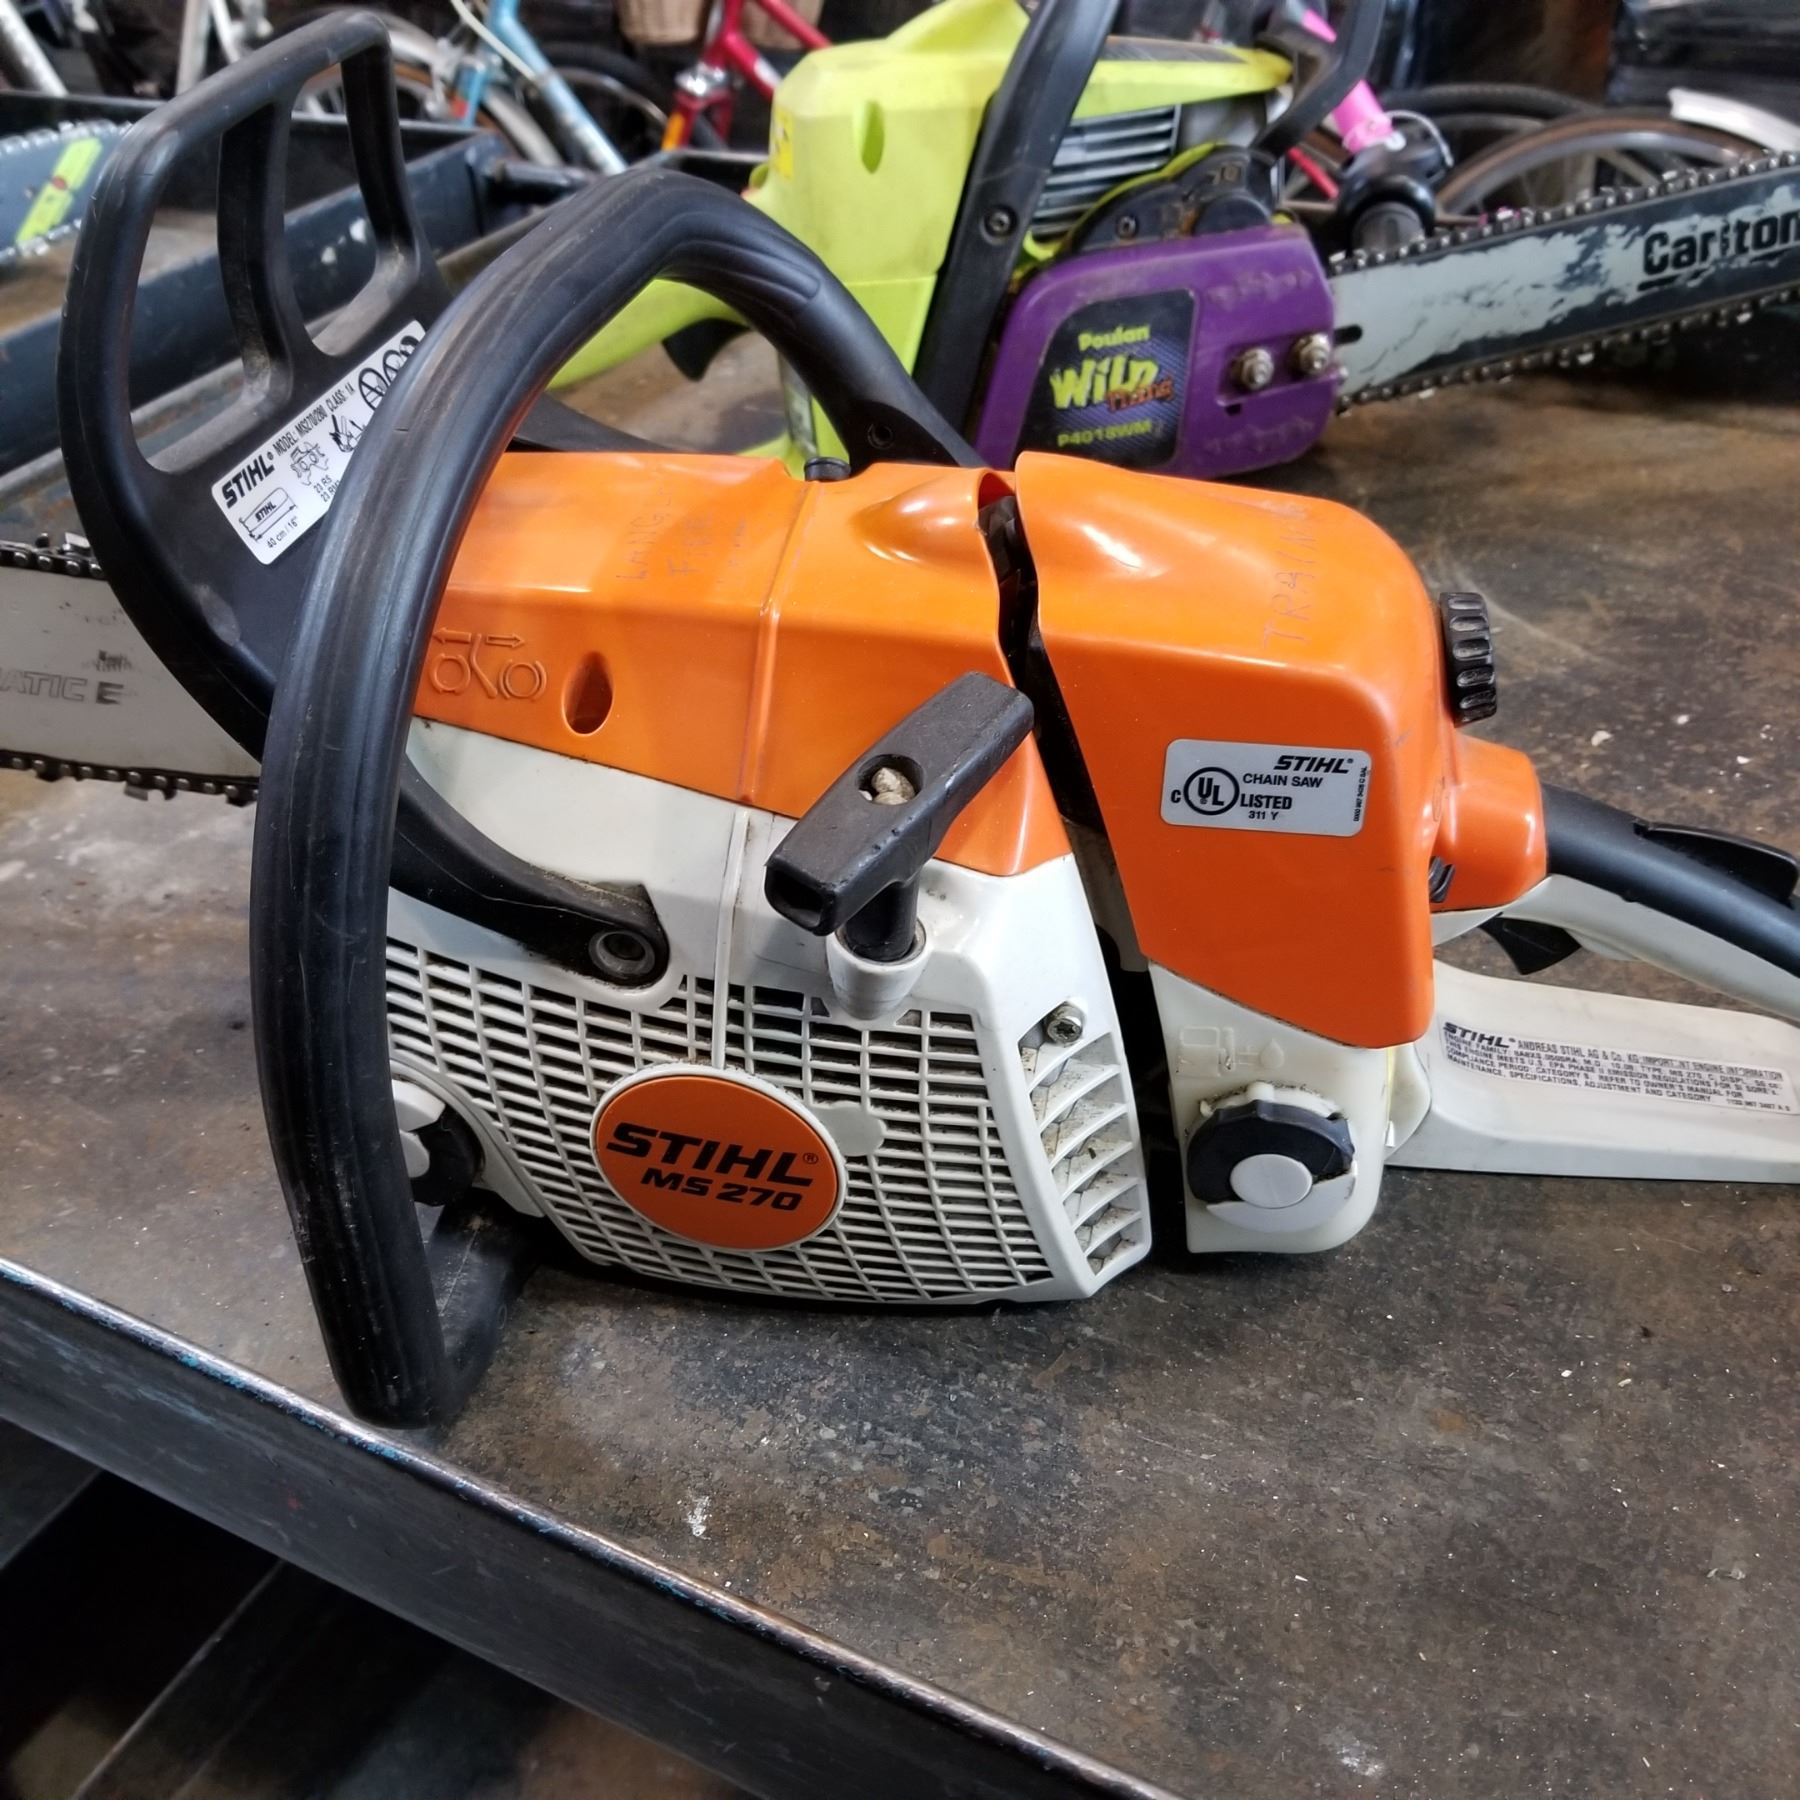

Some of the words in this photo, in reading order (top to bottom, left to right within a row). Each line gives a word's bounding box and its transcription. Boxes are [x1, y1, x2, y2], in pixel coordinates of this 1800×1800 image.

[1078, 325, 1150, 352] Poulan
[272, 430, 299, 456] MODEL:
[255, 501, 277, 522] STIHL
[267, 537, 278, 549] 40
[1242, 772, 1288, 787] CHAIN
[1291, 776, 1323, 788] SAW
[1240, 793, 1293, 810] LISTED
[1248, 810, 1266, 820] 311
[1270, 810, 1279, 820] Y
[1518, 1040, 1558, 1054] ANDREAS
[1560, 1045, 1585, 1058] STIHL
[641, 1167, 713, 1196] MS
[716, 1182, 803, 1212] 270
